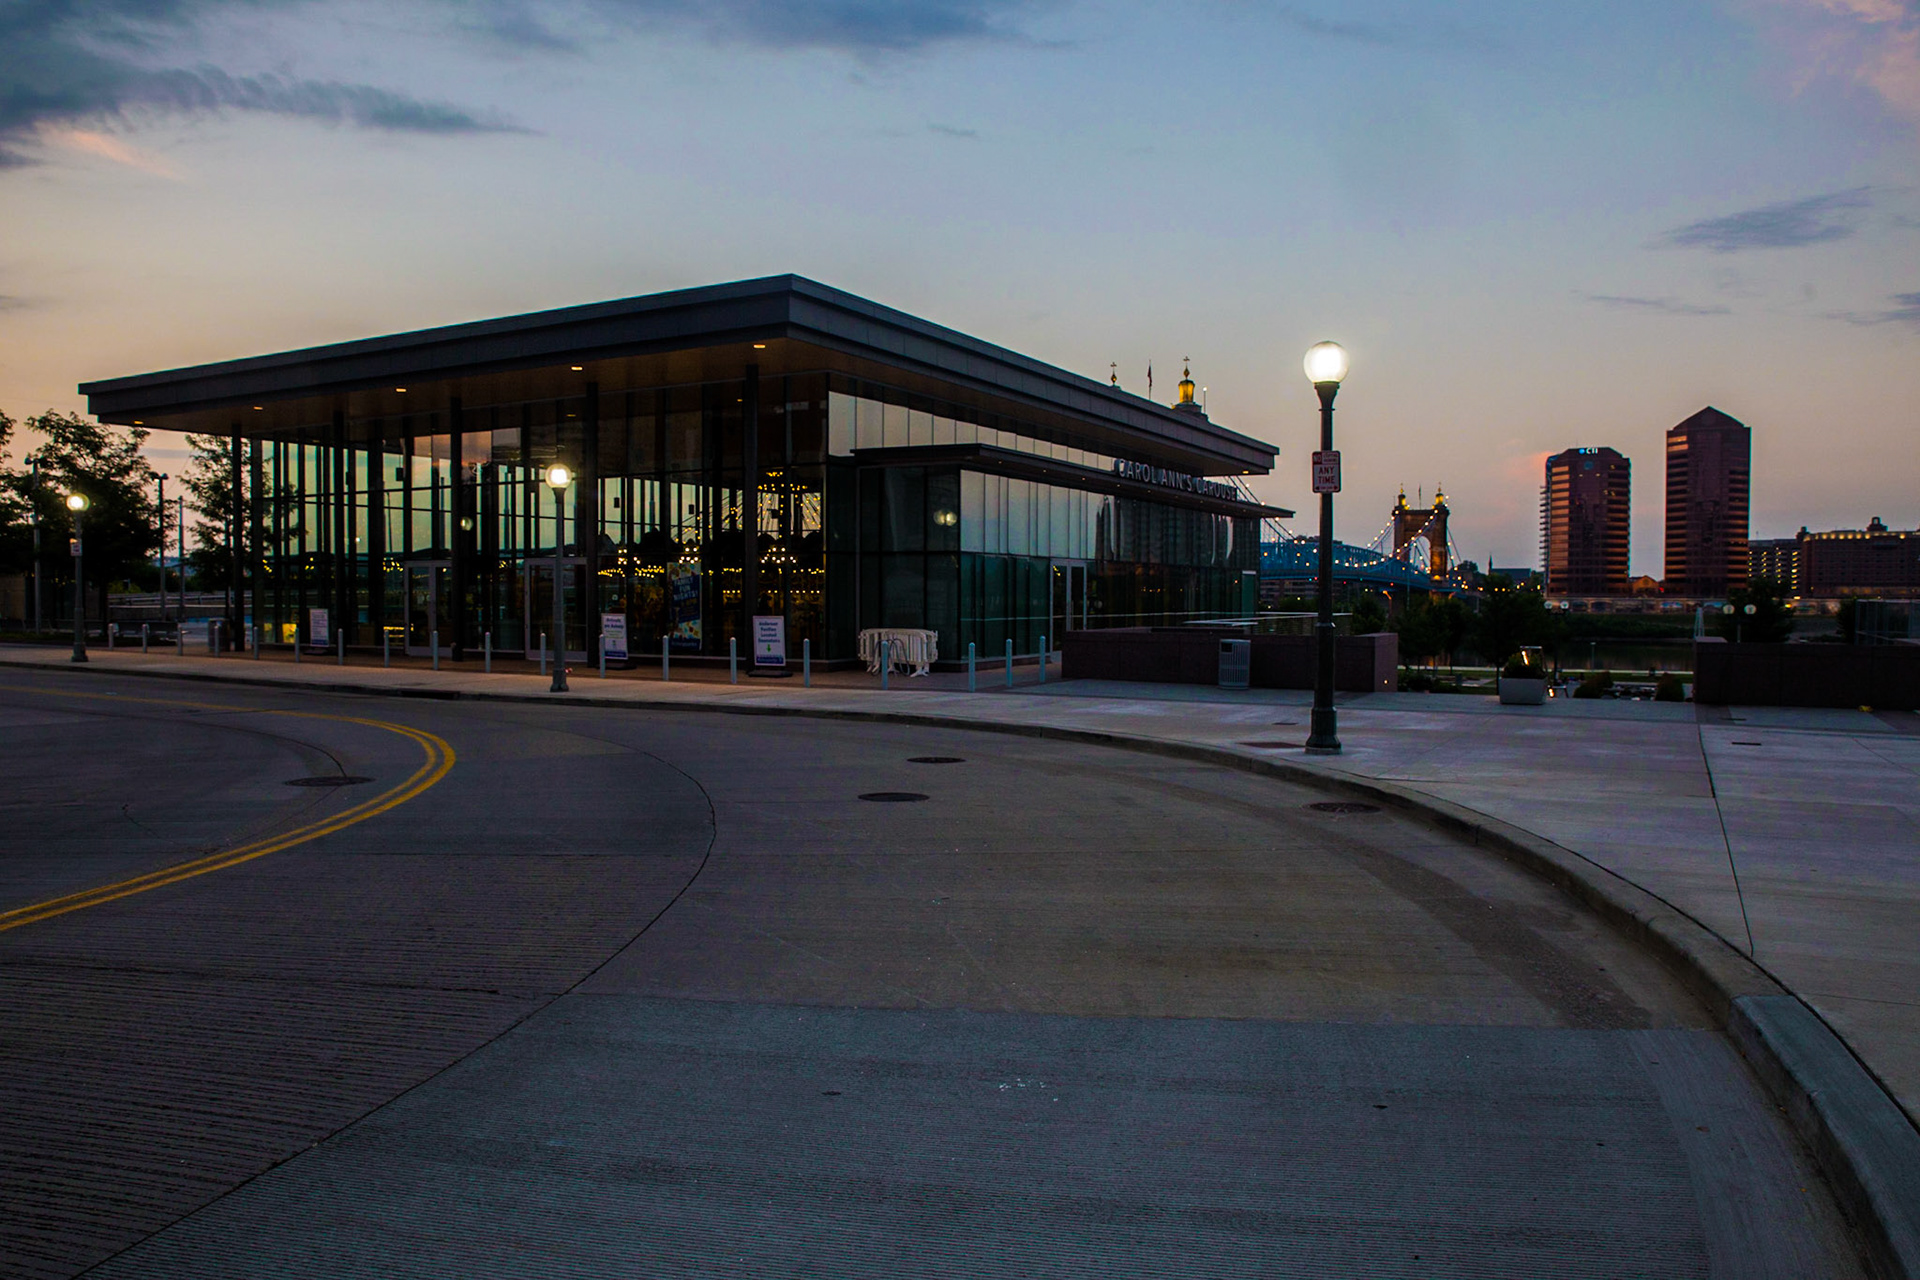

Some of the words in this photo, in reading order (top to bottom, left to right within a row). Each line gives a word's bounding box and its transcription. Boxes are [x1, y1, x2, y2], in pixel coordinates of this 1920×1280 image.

[1313, 453, 1322, 463] NO
[1318, 466, 1335, 474] ANY
[1118, 458, 1158, 484] CAROL
[1161, 468, 1192, 492] ANN'S
[1318, 475, 1335, 484] TIME
